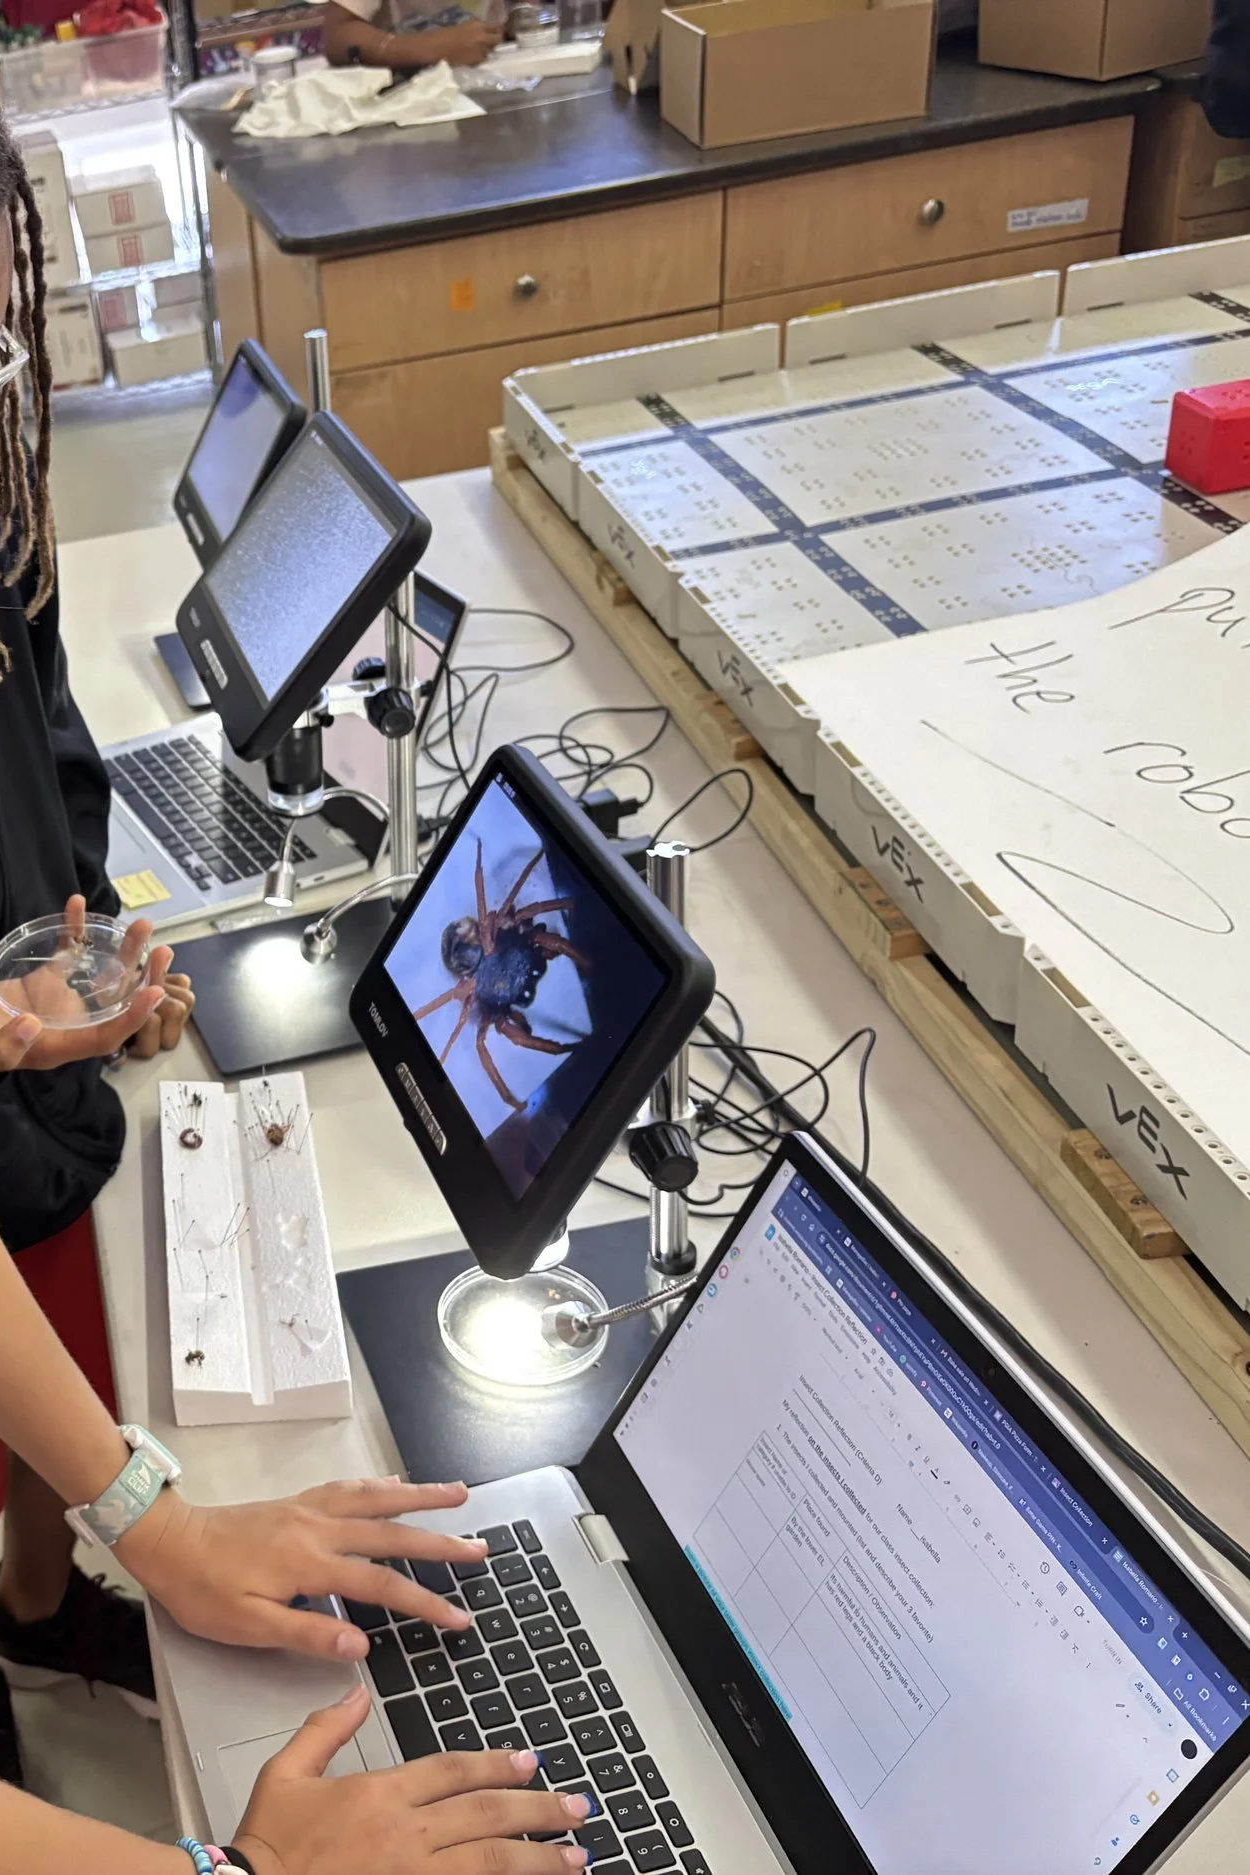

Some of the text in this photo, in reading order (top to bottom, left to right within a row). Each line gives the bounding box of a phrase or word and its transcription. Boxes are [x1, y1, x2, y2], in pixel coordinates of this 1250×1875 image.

[607, 524, 636, 567] VEX
[1108, 587, 1250, 649] pu
[717, 651, 754, 706] VEX
[965, 640, 1075, 714] the
[871, 826, 924, 903] VEX
[369, 1001, 390, 1039] TOMLOV
[1106, 1083, 1191, 1200] VEX
[822, 1288, 846, 1319] Collection
[844, 1314, 868, 1345] Reflection
[798, 1373, 814, 1395] Insect
[811, 1390, 835, 1423] Collection
[832, 1418, 857, 1452] Reflection
[854, 1447, 875, 1477] (Criteria
[895, 1502, 913, 1526] Name
[781, 1398, 791, 1413] My
[788, 1407, 810, 1438] reflection
[807, 1434, 816, 1448] on
[813, 1442, 825, 1459] the
[821, 1453, 842, 1482] insects
[841, 1480, 867, 1516] collected
[879, 1532, 895, 1554] class
[893, 1550, 911, 1575] insect
[907, 1570, 936, 1610] collection:
[802, 1497, 831, 1538] Place found
[1059, 1486, 1093, 1527] Insect Collection
[781, 1430, 792, 1445] The
[790, 1442, 807, 1466] insects
[807, 1465, 829, 1497] collected
[835, 1505, 858, 1537] mounted
[874, 1559, 897, 1592] describe
[894, 1589, 908, 1609] your
[909, 1610, 934, 1645] favorite)
[785, 1522, 803, 1549] garden
[804, 1534, 819, 1557] lower
[841, 1554, 870, 1596] Description
[870, 1594, 903, 1641] Observation
[1121, 1560, 1140, 1582] Isabella
[835, 1581, 855, 1610] harmful
[858, 1614, 880, 1646] humans
[877, 1643, 890, 1661] and
[887, 1657, 909, 1689] animals
[840, 1604, 854, 1624] legs
[865, 1639, 881, 1663] black
[877, 1659, 893, 1683] body
[759, 1667, 782, 1703] collection
[1144, 1691, 1163, 1714] Share
[1189, 1707, 1218, 1742] Bookmarks
